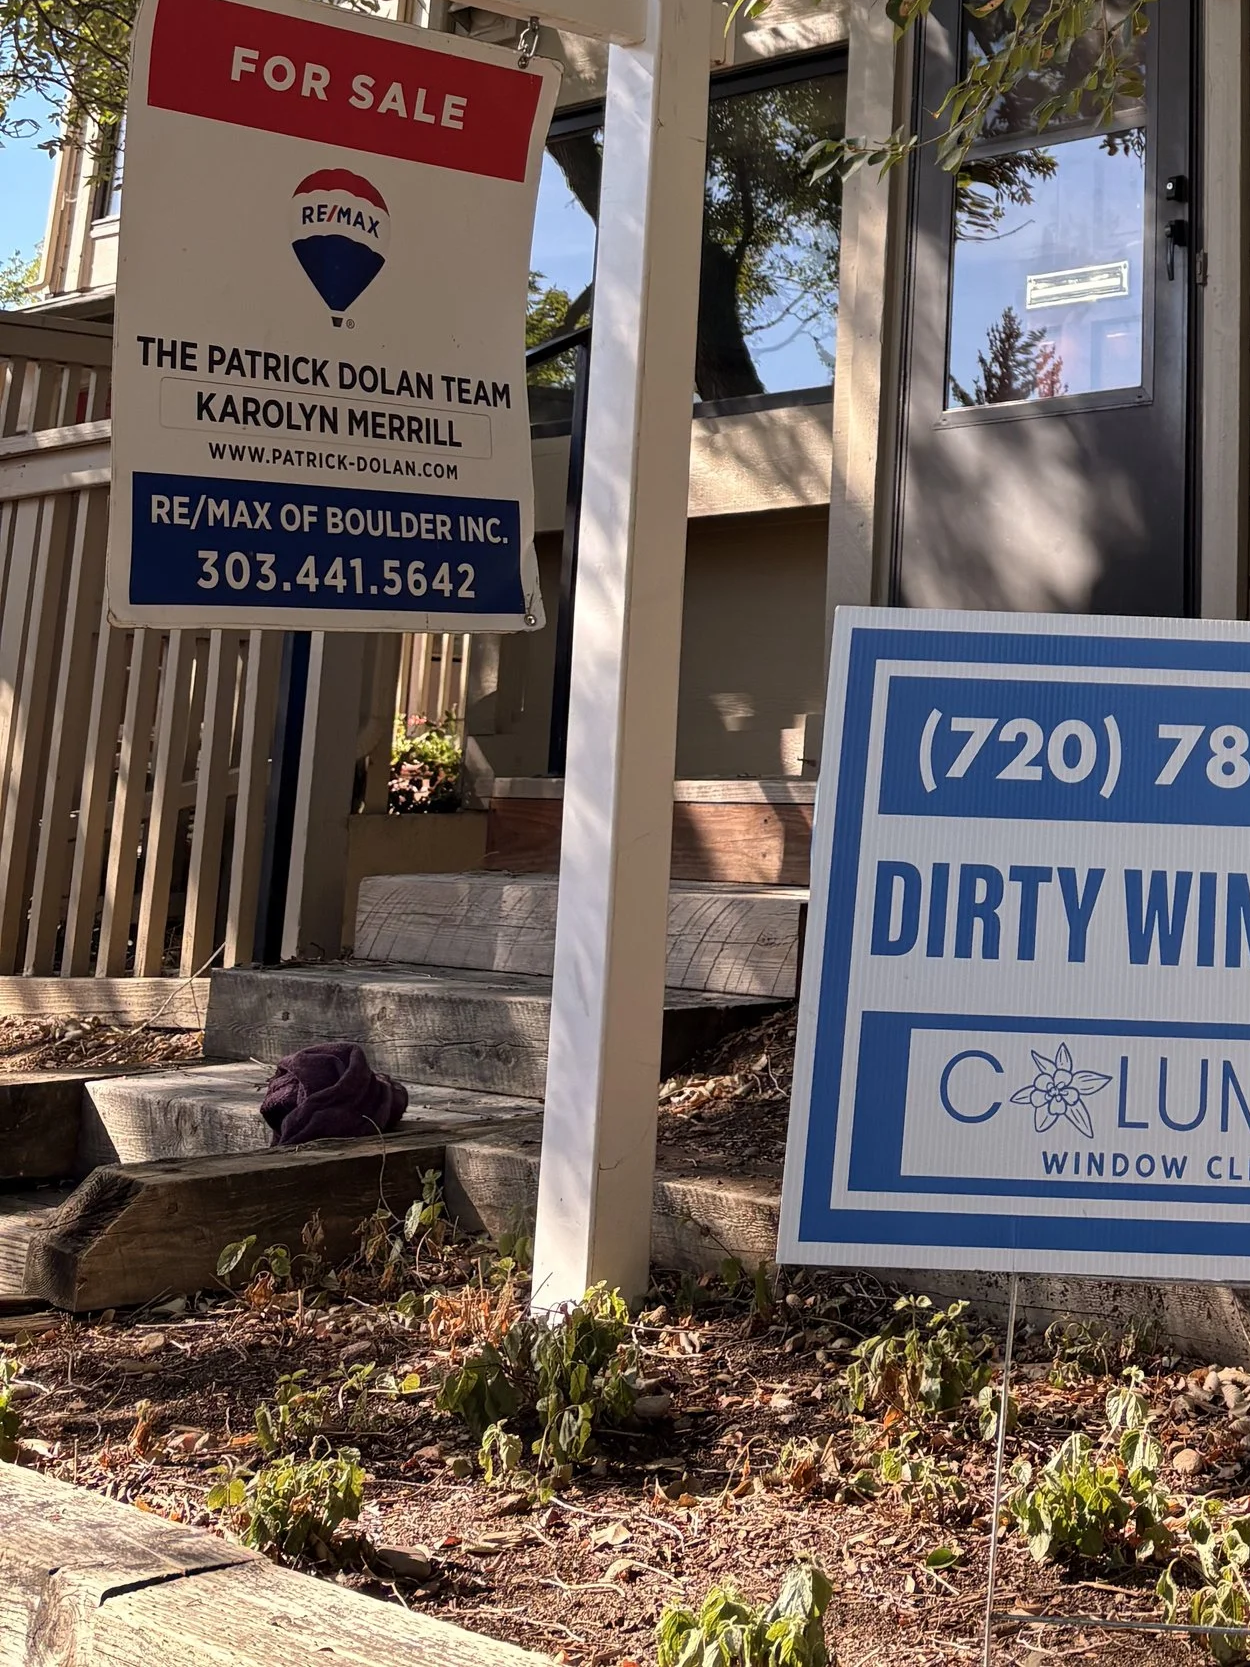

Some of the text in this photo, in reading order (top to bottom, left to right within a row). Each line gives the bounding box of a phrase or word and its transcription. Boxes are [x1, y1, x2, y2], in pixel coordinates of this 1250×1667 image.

[231, 45, 468, 130] FOR SALE
[302, 203, 381, 238] RE/MAX
[137, 336, 511, 409] THE PATRICK DOLAN TEAM
[196, 391, 462, 447] KAROLYN MERRILL
[209, 442, 458, 480] WWW.PATRICK-DOLAN.COM
[151, 494, 509, 544] RE/MAX OF BOULDER INC.
[196, 550, 476, 598] 303.441.5642
[920, 708, 1122, 798] (720)
[871, 860, 1105, 964] DIRTY
[1042, 1151, 1187, 1180] WINDOW
